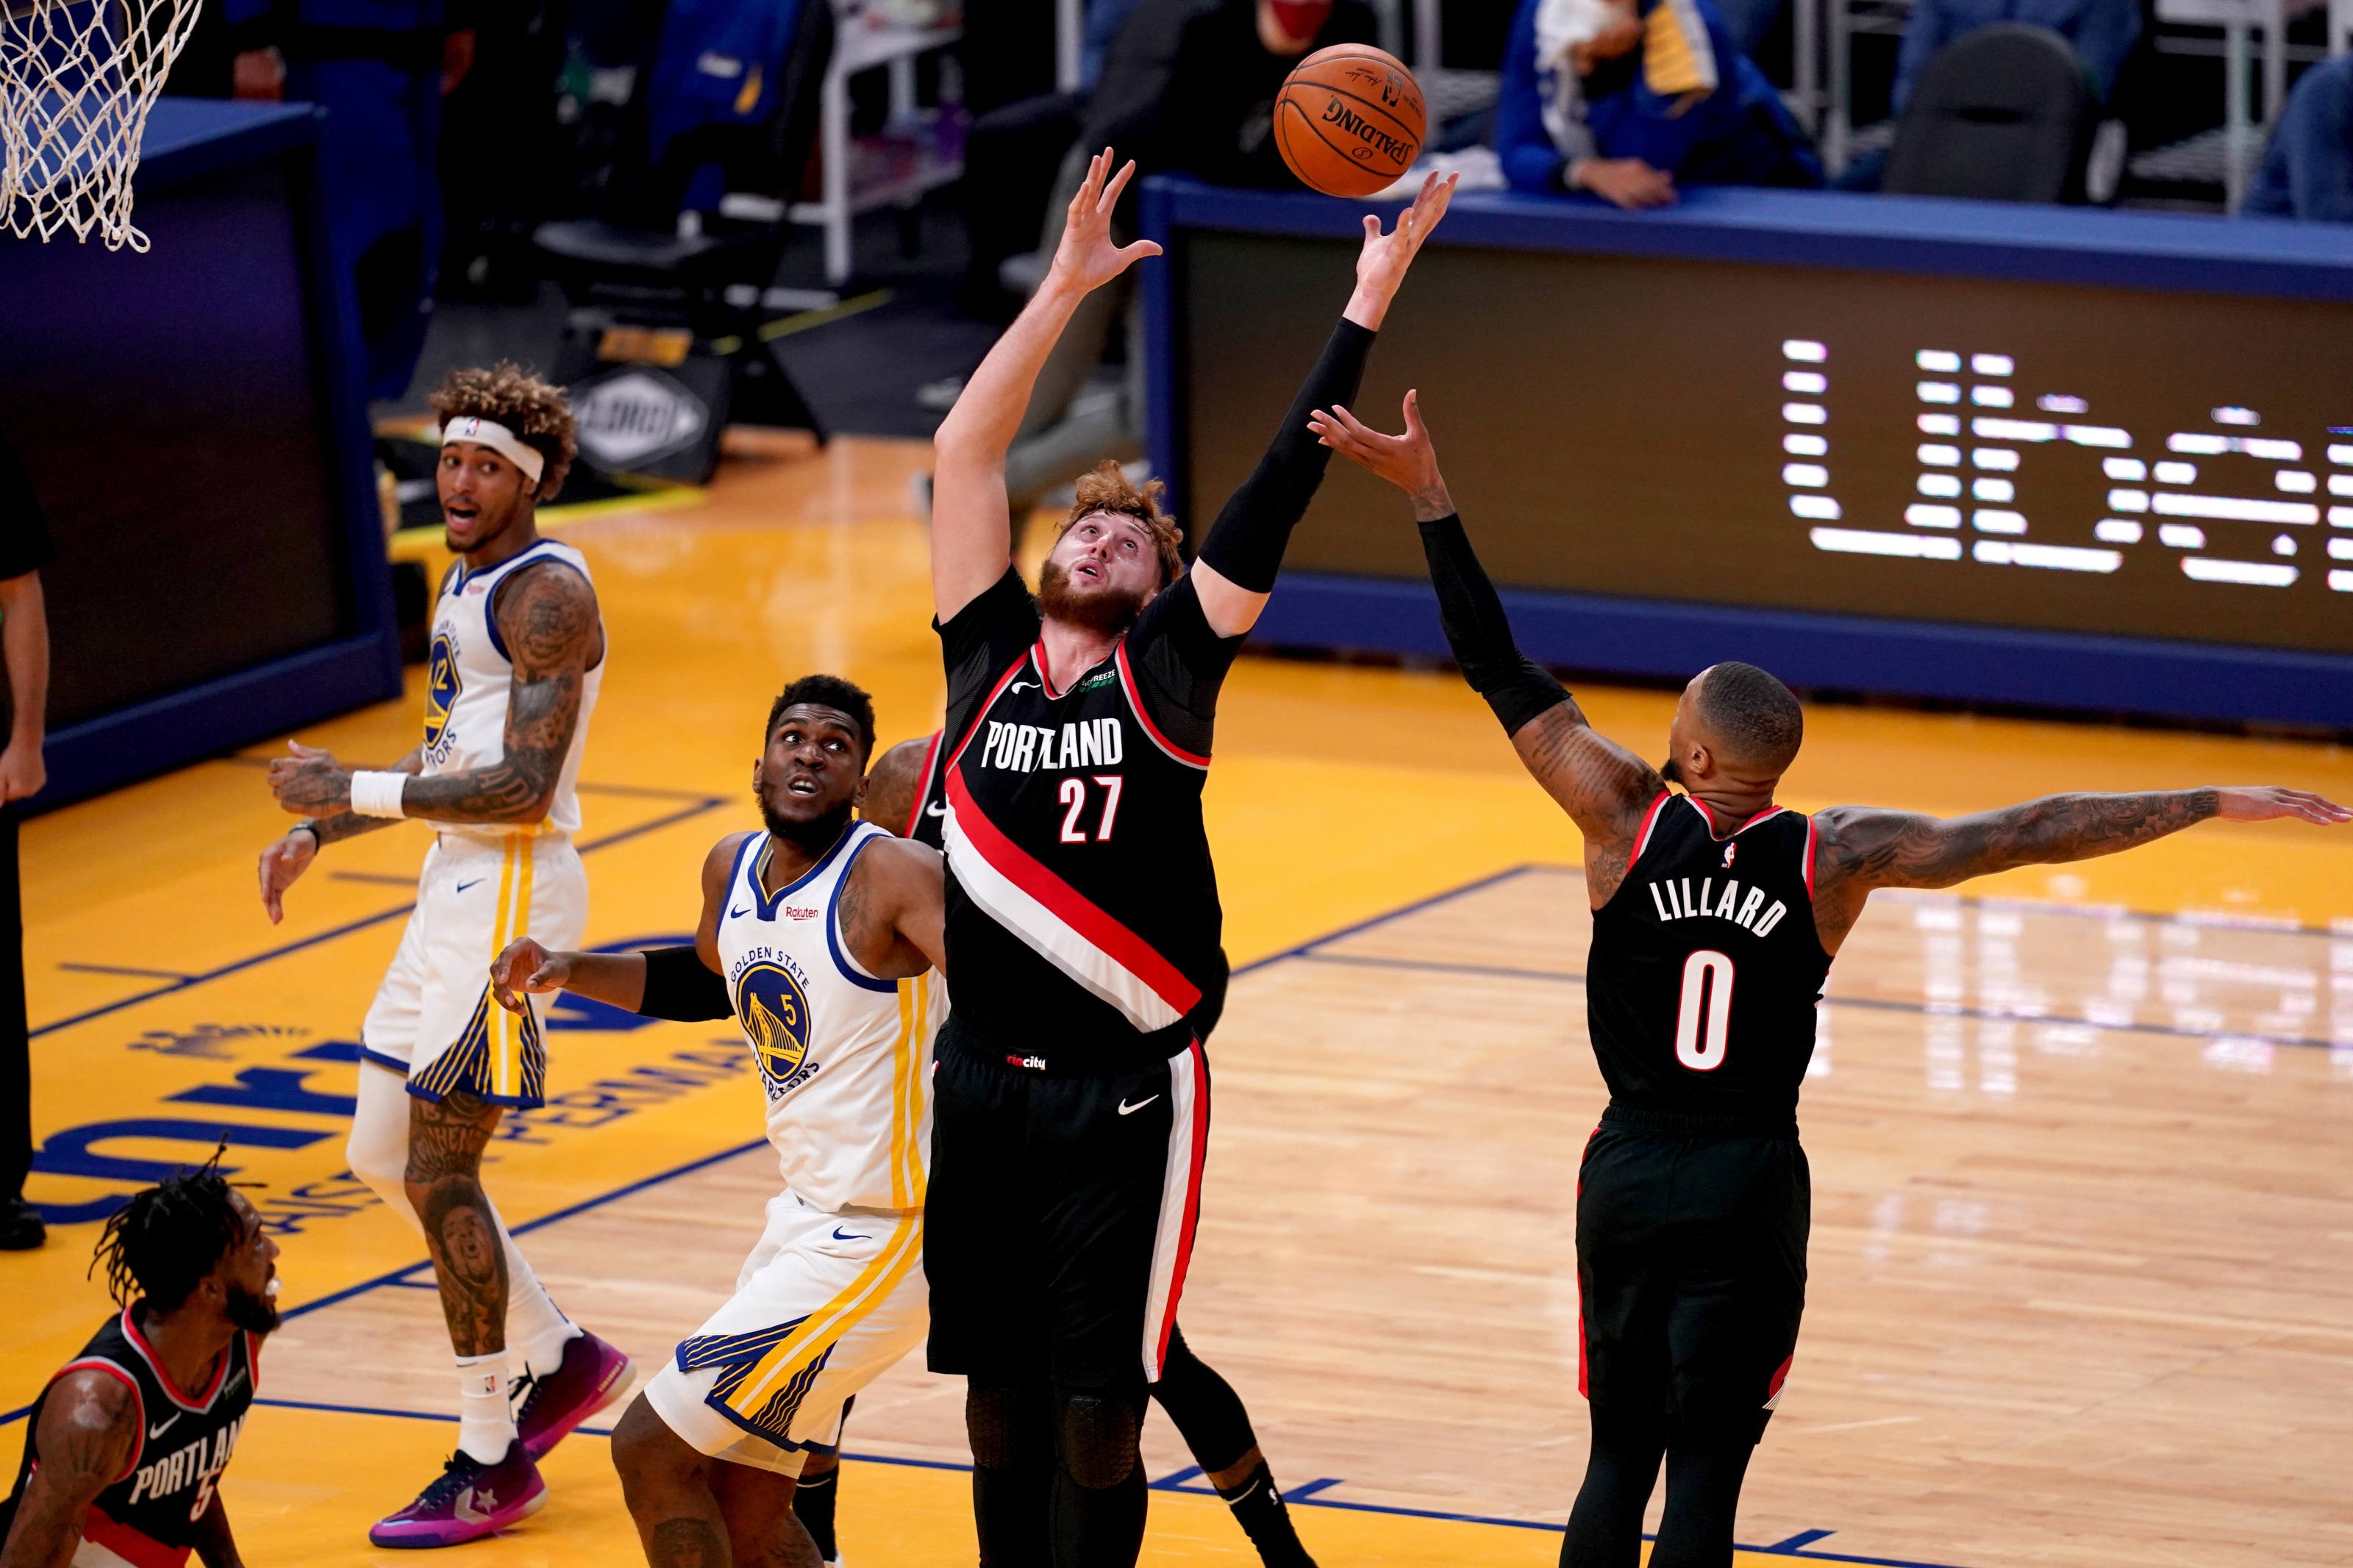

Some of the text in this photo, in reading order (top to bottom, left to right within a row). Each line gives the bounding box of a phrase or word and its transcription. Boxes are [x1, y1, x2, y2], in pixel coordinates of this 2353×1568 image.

[1321, 98, 1413, 166] SPALDING
[980, 717, 1123, 773] PORTLAND
[1059, 775, 1123, 843] 27
[786, 906, 818, 918] Rakuten
[1649, 877, 1787, 938] LILLARD
[731, 946, 810, 989] GOLDEN STATE
[780, 994, 797, 1026] 5
[1674, 949, 1735, 1071] 0
[129, 1414, 246, 1506] PORTLAN
[190, 1469, 221, 1523] 5
